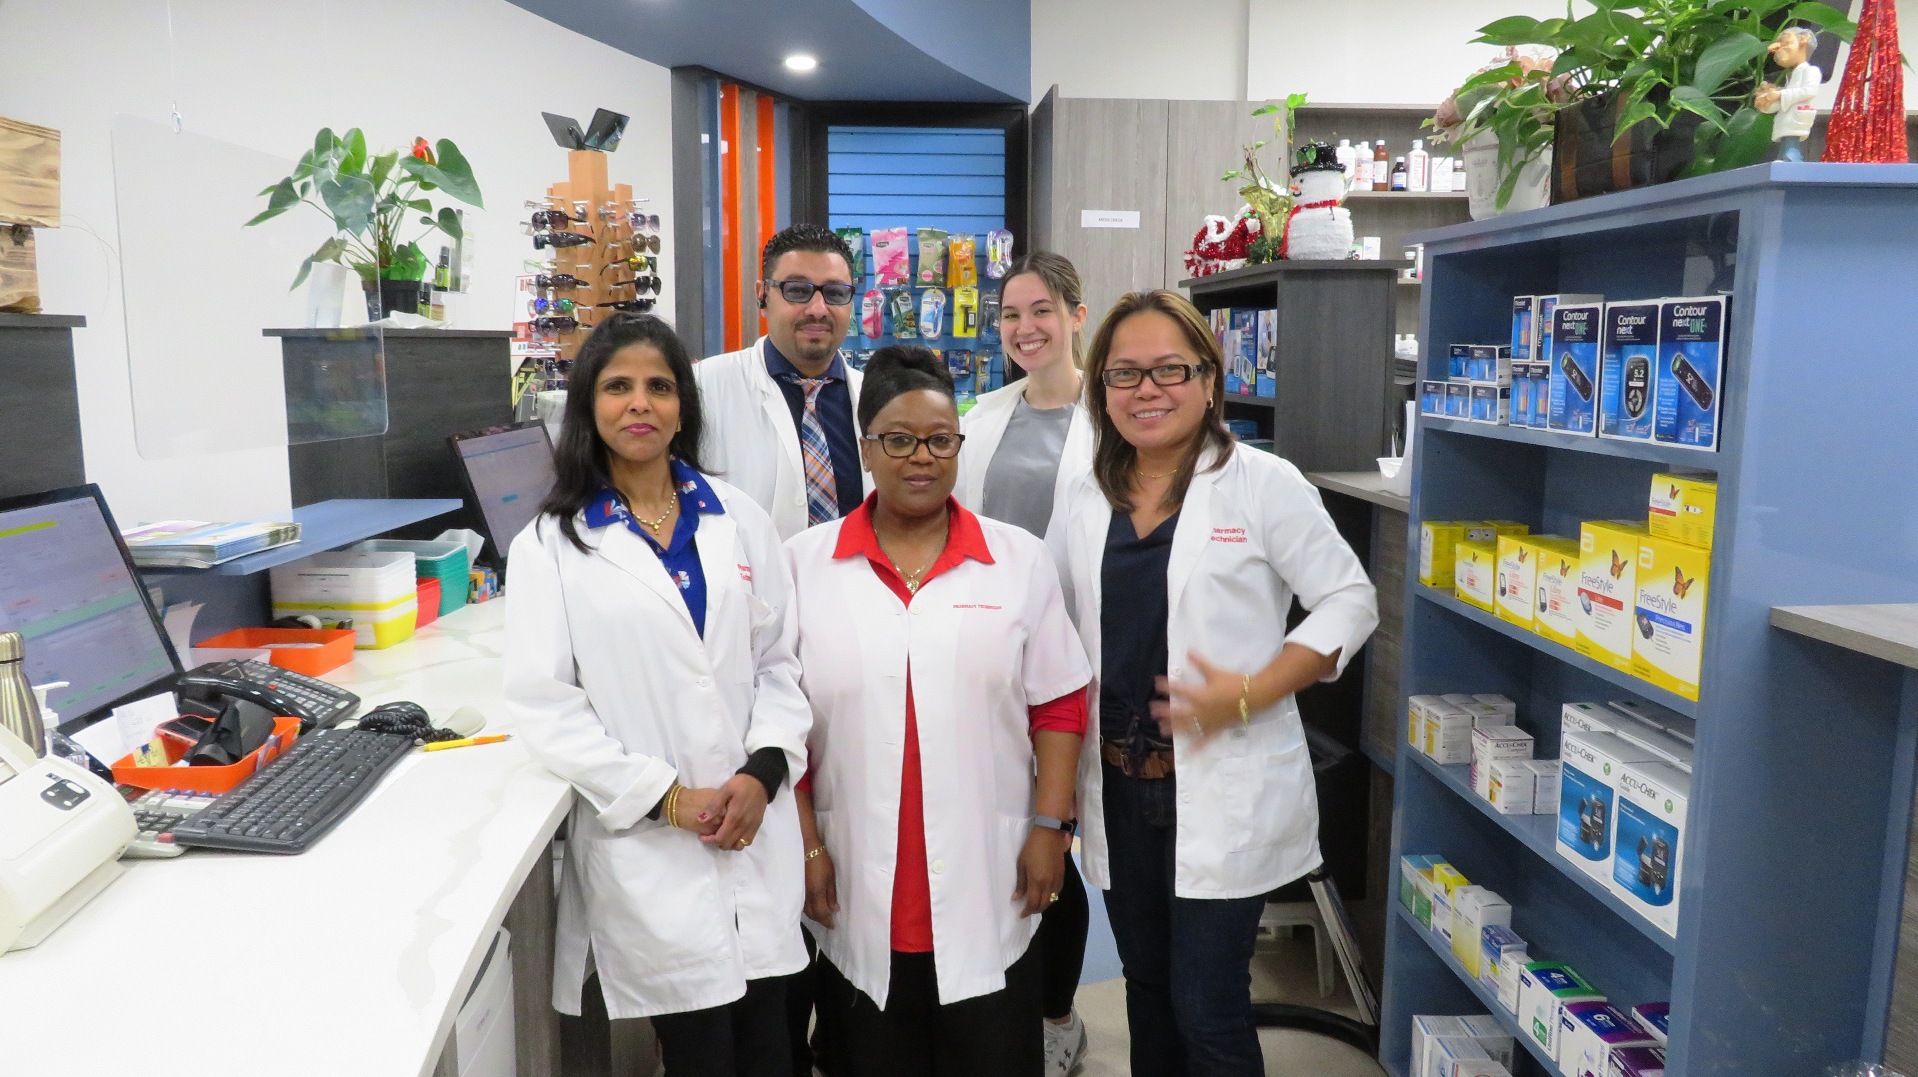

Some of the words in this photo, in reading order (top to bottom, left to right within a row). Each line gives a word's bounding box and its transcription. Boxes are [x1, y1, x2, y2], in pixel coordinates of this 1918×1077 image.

[1563, 311, 1589, 321] Contour
[1673, 305, 1707, 317] Contour
[1562, 321, 1575, 330] next
[1617, 315, 1646, 326] Contour
[1672, 318, 1690, 328] next
[1690, 318, 1706, 334] ONE
[1616, 326, 1633, 335] next
[1634, 369, 1645, 378] 5.2
[1581, 572, 1614, 594] FreeStyle
[1640, 590, 1677, 614] FreeStyle
[1564, 740, 1595, 763] ACCU-CHEK
[1620, 773, 1656, 800] ACCU-CHEK
